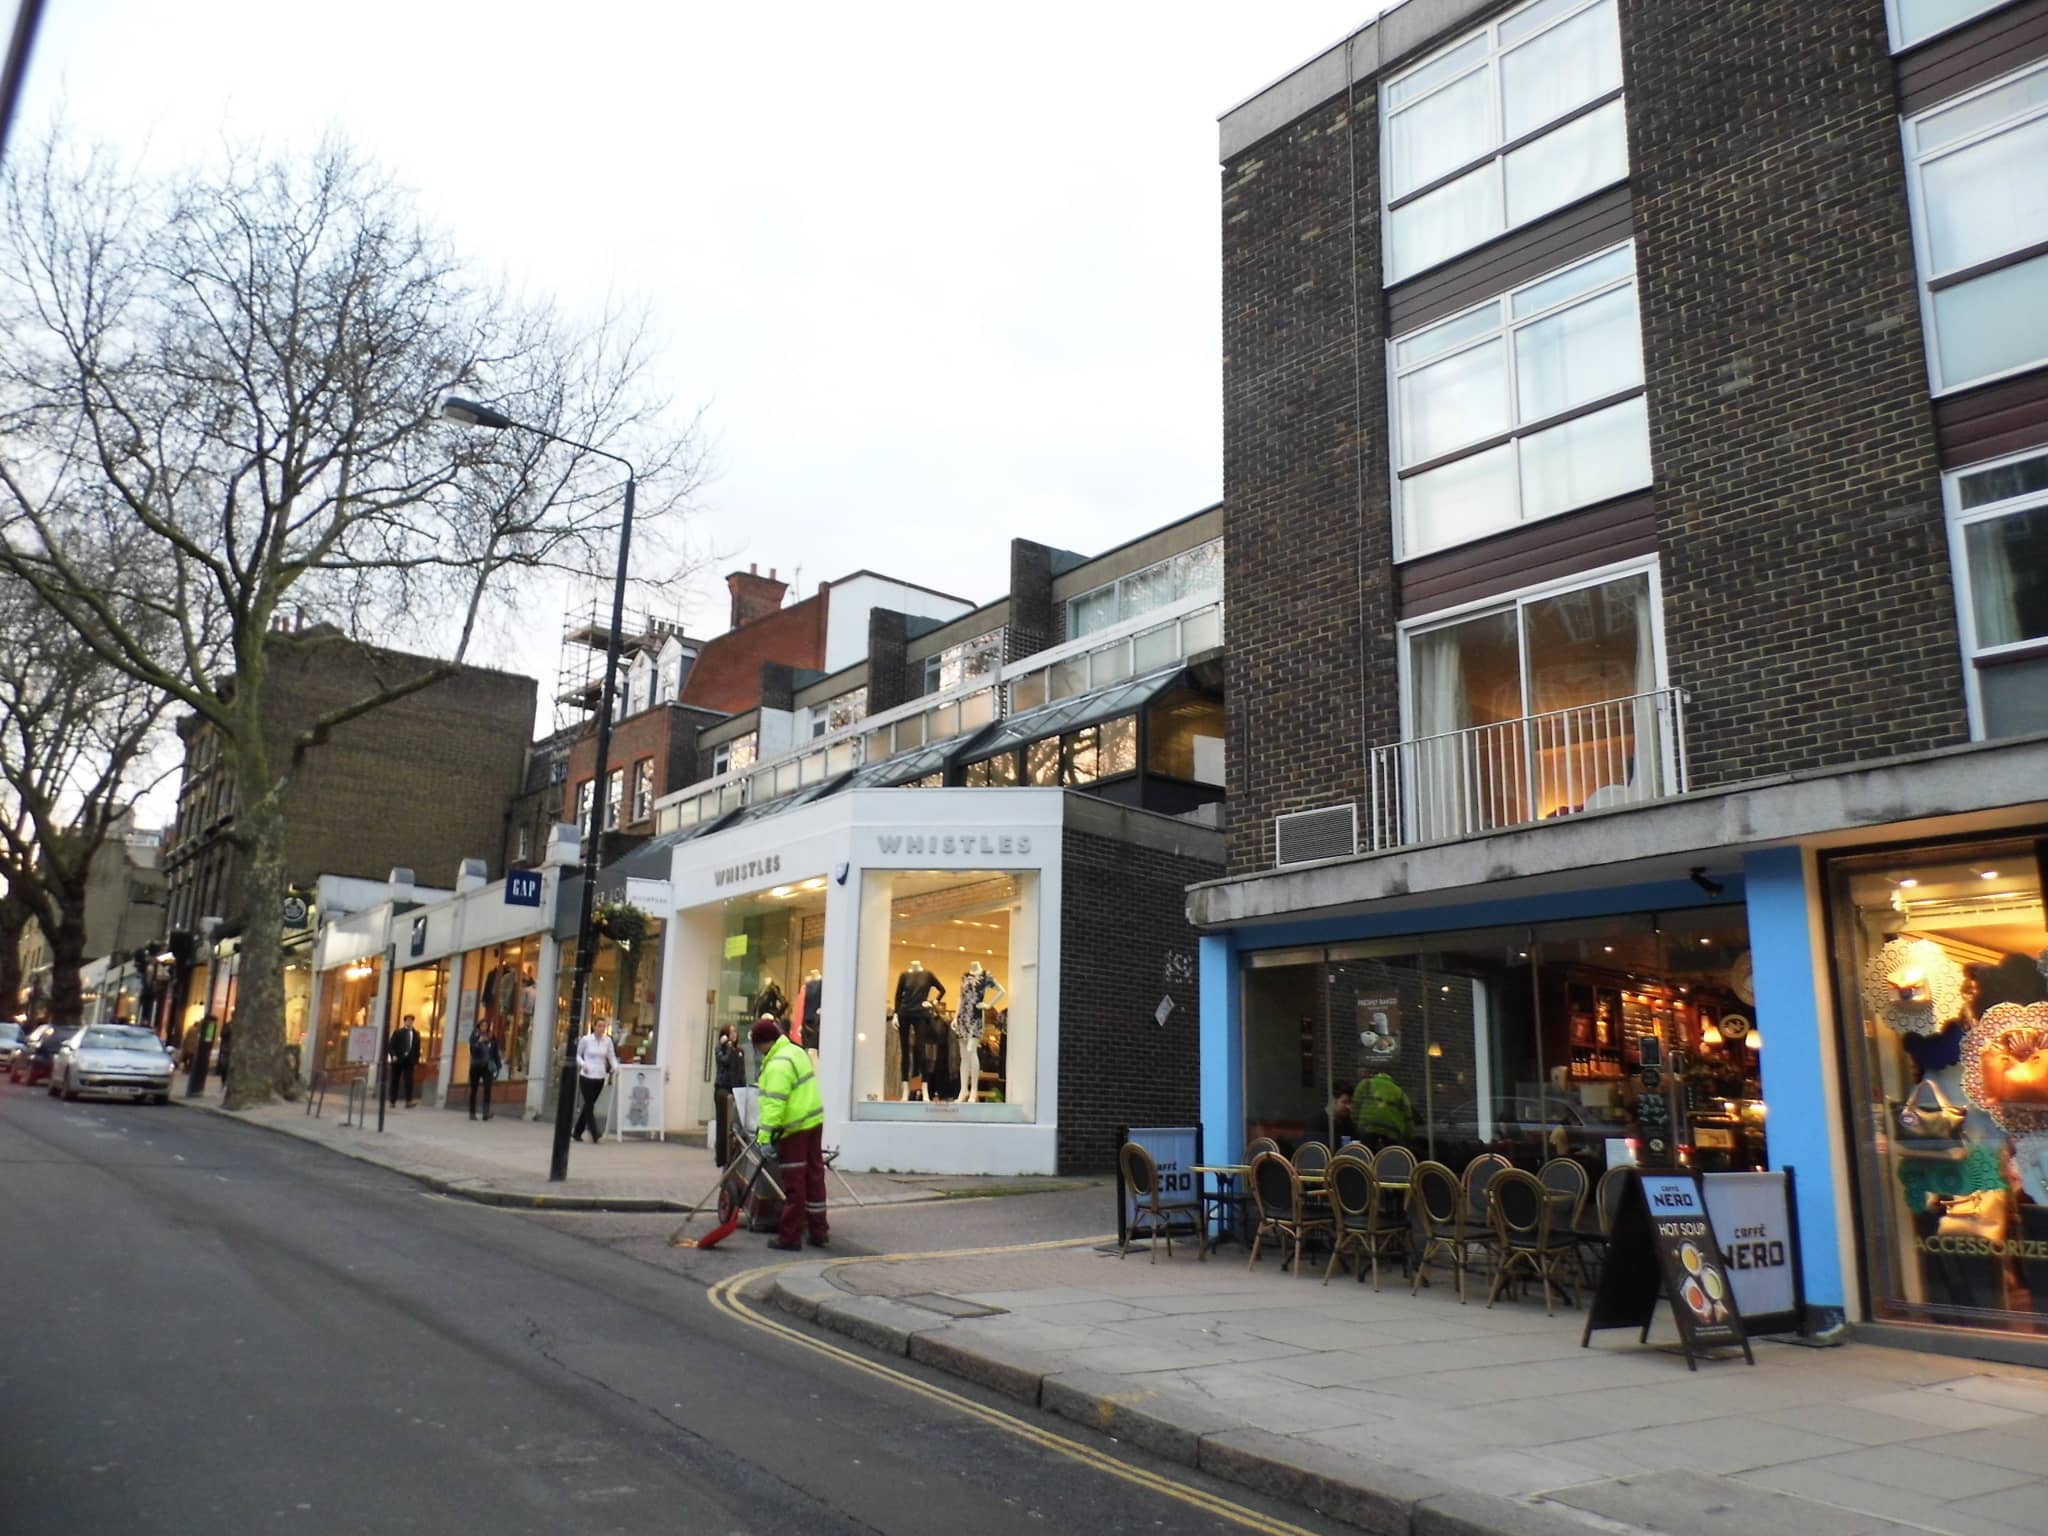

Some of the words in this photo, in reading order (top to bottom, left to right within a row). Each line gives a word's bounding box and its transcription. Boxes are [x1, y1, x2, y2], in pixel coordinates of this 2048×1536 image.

[877, 835, 1032, 855] WHISTLES
[714, 855, 781, 887] WHISTLES
[512, 879, 536, 898] GAP
[1157, 1172, 1191, 1193] ERO
[1653, 1193, 1693, 1207] NERO
[1658, 1222, 1679, 1237] HOT
[1680, 1221, 1706, 1237] SOUP
[1721, 1240, 1785, 1271] NERO
[1917, 1234, 2048, 1259] ACCESSORIZE
